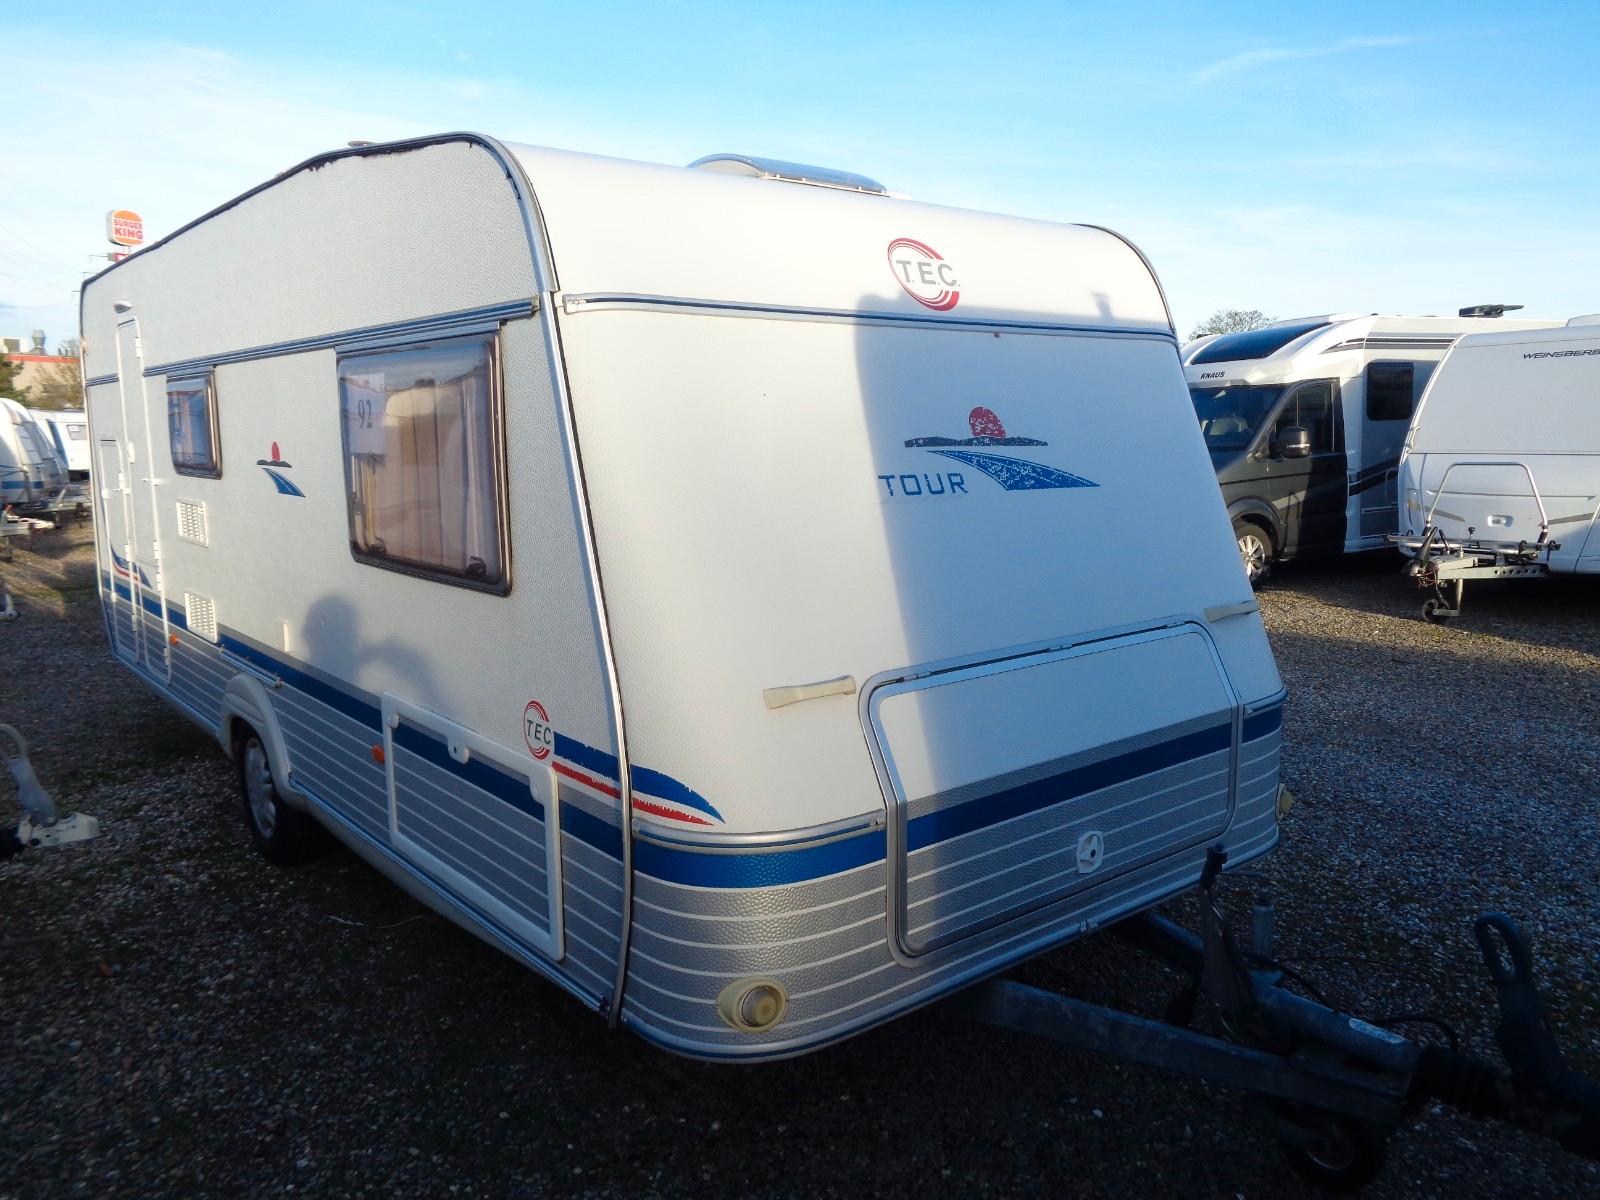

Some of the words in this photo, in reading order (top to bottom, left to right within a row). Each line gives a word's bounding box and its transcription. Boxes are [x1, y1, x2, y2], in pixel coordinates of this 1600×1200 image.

[113, 219, 143, 230] BURGER
[114, 227, 143, 239] KING
[1200, 371, 1225, 380] KNAUS
[357, 399, 373, 429] 92
[877, 472, 968, 497] TOUR
